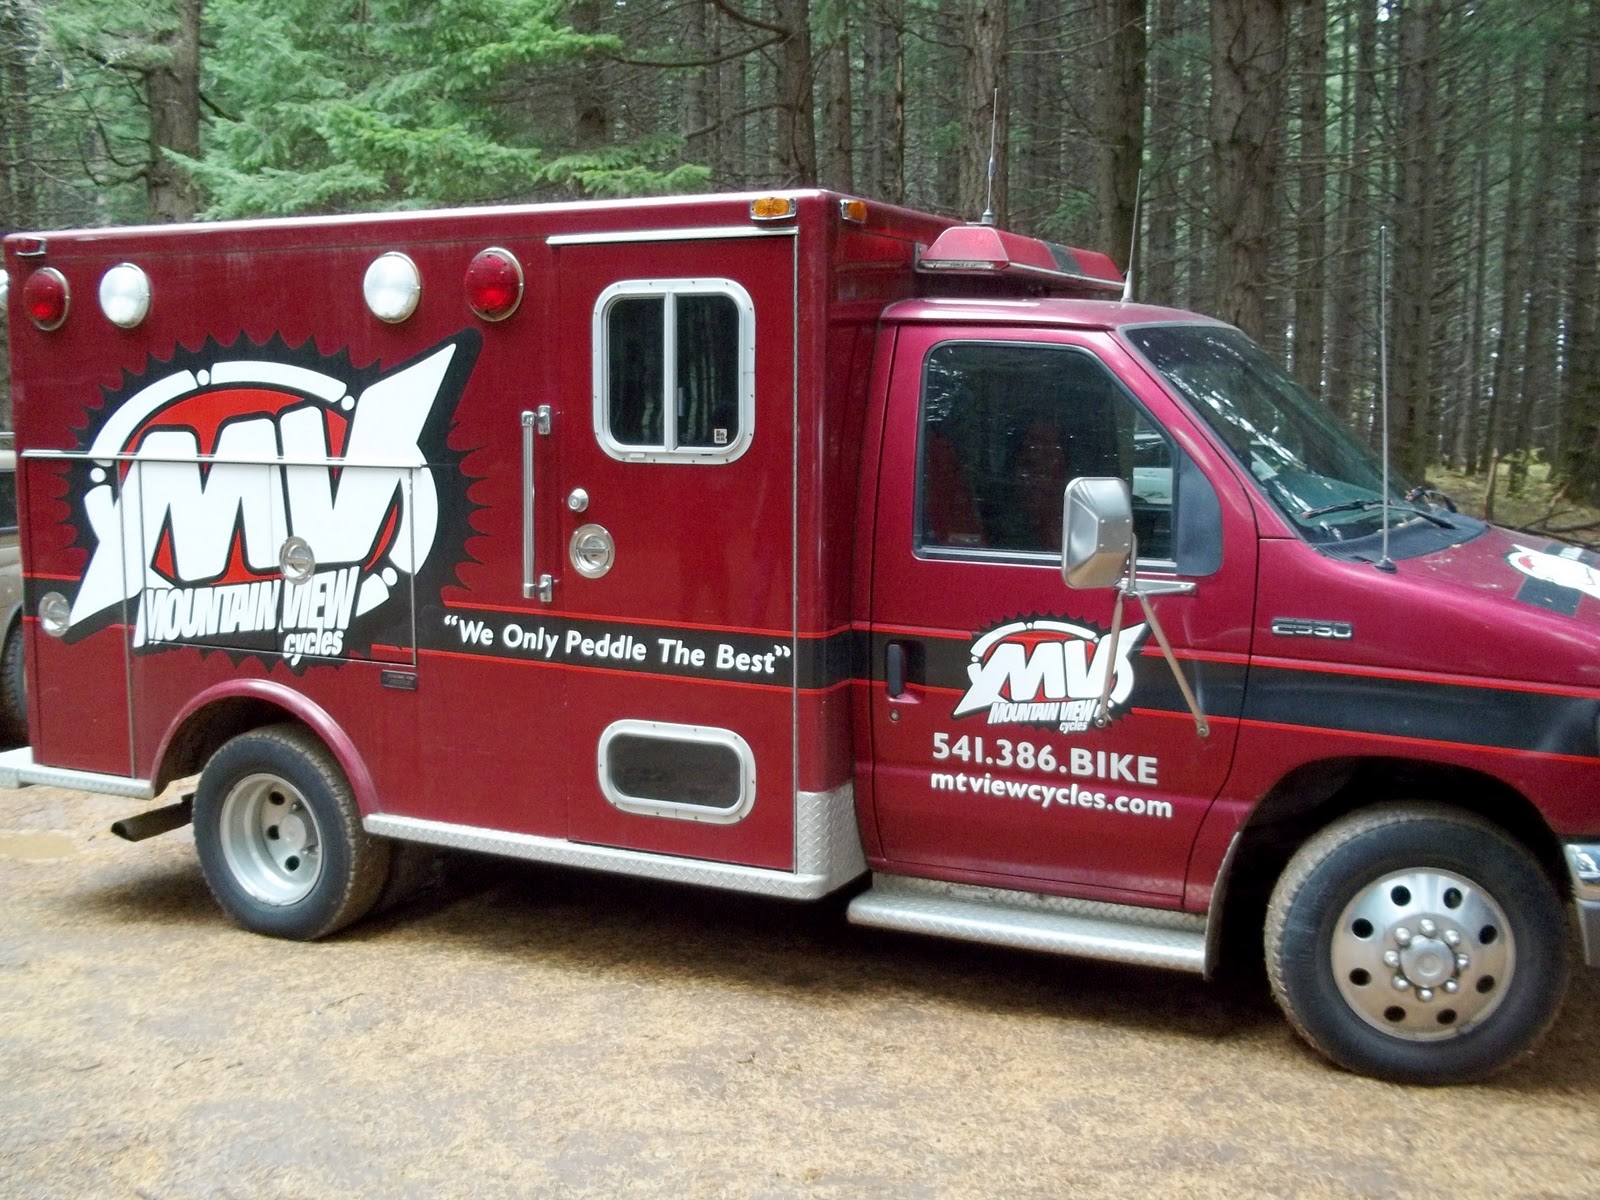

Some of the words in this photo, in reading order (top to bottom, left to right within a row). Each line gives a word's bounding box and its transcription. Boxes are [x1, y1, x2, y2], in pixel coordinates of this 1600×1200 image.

[133, 579, 281, 648] MOUNTAIN
[281, 566, 360, 631] VIEW
[282, 628, 344, 666] cycles
[502, 624, 559, 658] Only
[565, 630, 647, 661] Peddle
[658, 638, 705, 667] The
[987, 702, 1061, 725] MOUNTAIN
[1059, 698, 1098, 723] VIEW
[1059, 721, 1088, 734] cycles
[932, 731, 1159, 785] 541.386.BIKE
[930, 772, 1173, 818] mtviewcycles.com
